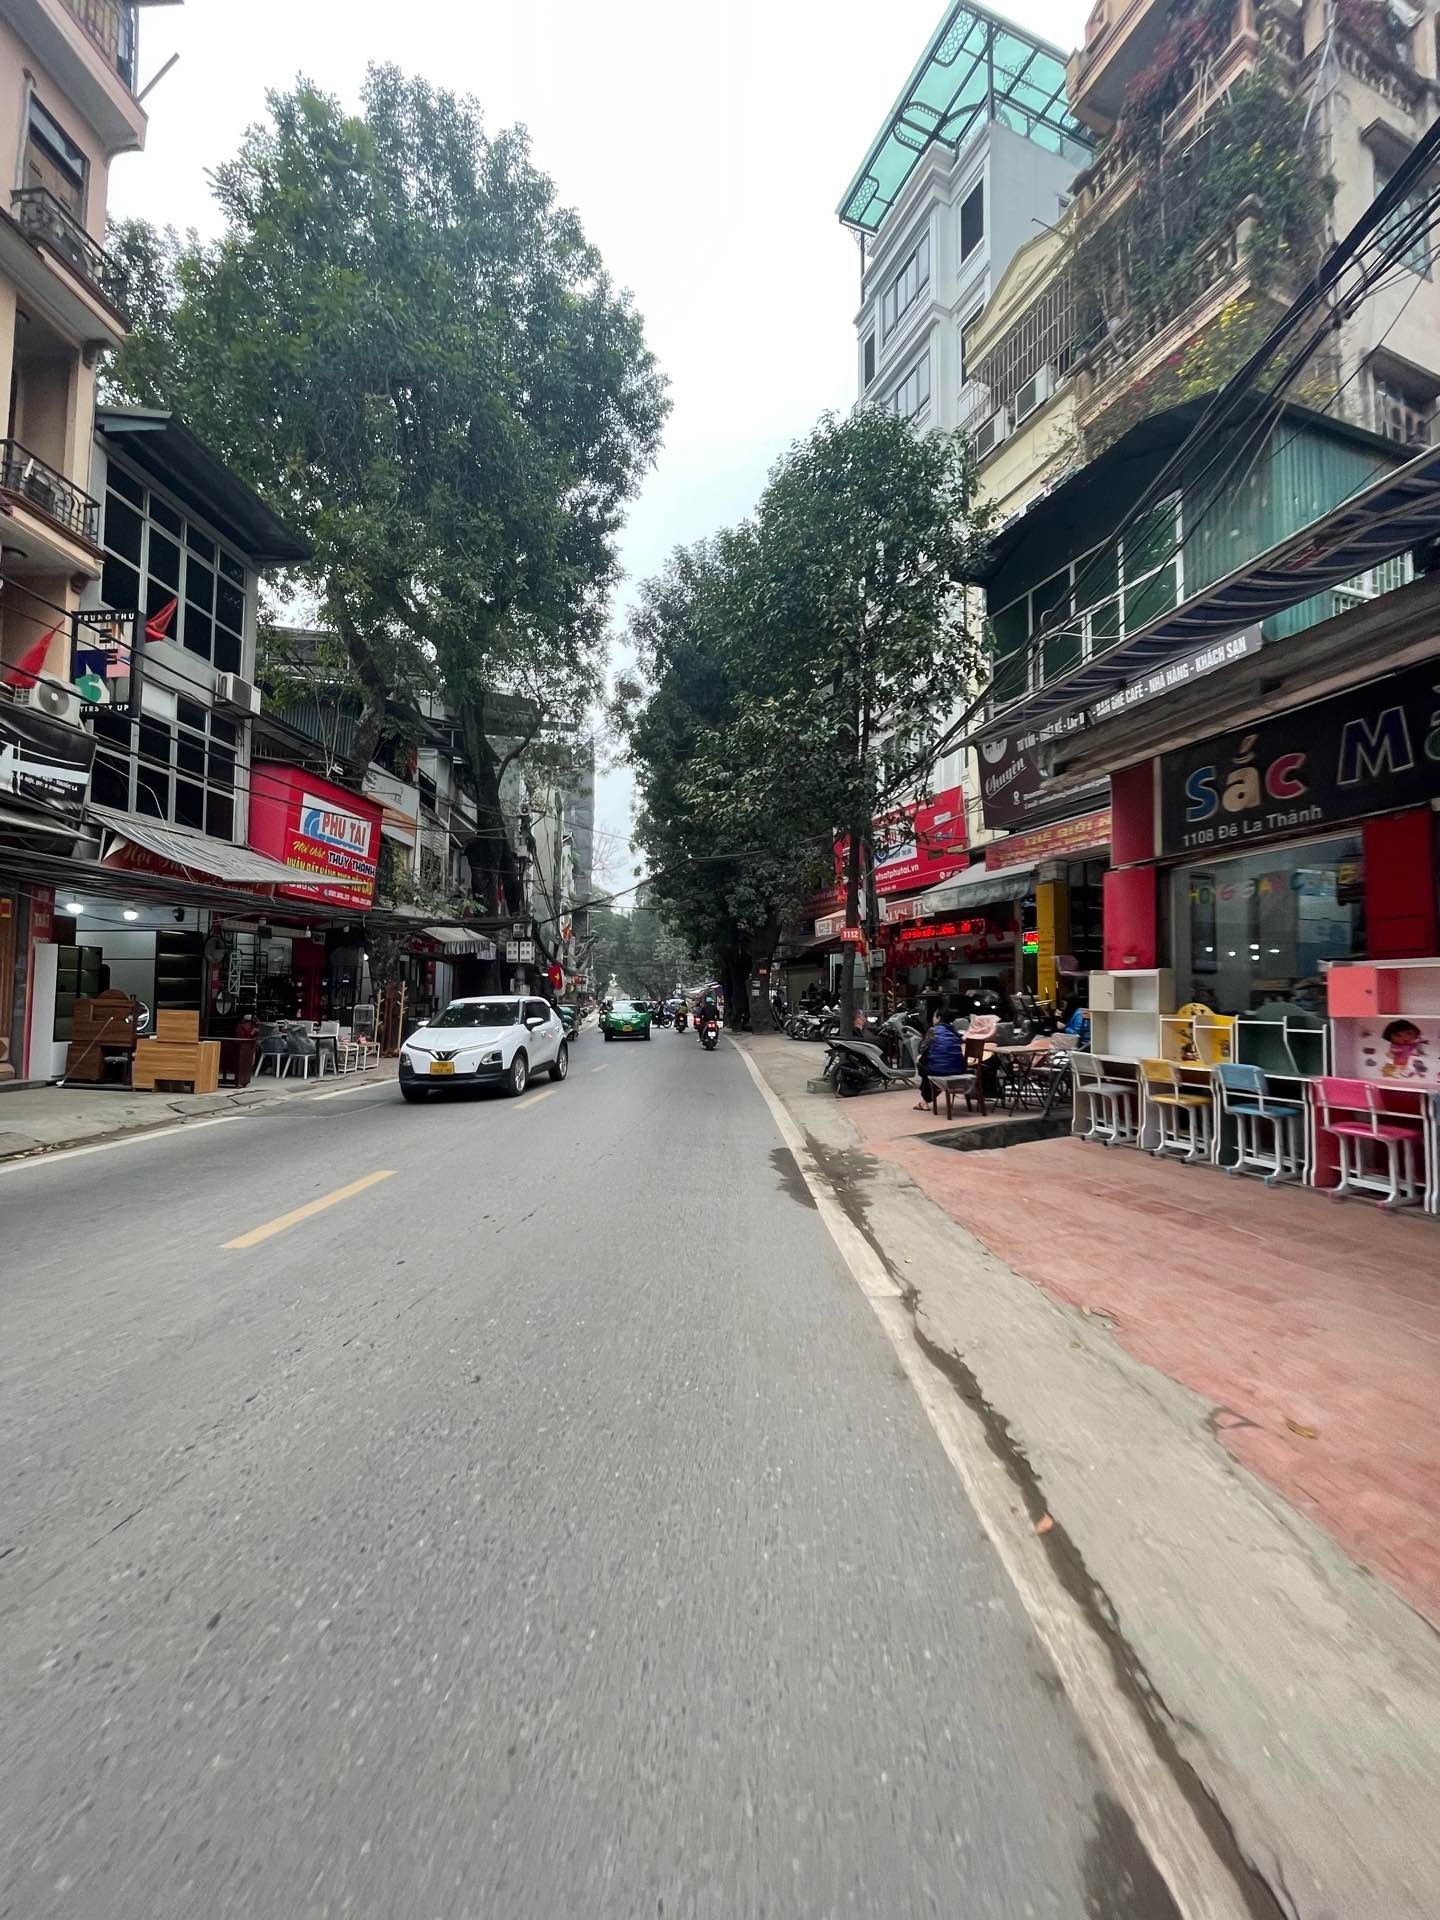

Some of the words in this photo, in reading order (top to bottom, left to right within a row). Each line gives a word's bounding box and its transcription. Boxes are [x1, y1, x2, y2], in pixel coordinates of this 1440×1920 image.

[115, 612, 135, 620] THU
[1148, 671, 1167, 693] NHÀ
[1166, 662, 1190, 686] HÀNG
[1195, 647, 1226, 672] KHÁCH
[1226, 636, 1248, 659] SẠN
[1185, 733, 1307, 823] Sắc
[1183, 828, 1214, 847] 1108
[1218, 823, 1239, 840] Đê
[1243, 819, 1263, 834] La
[1266, 804, 1323, 829] Thành
[842, 930, 859, 939] 1112
